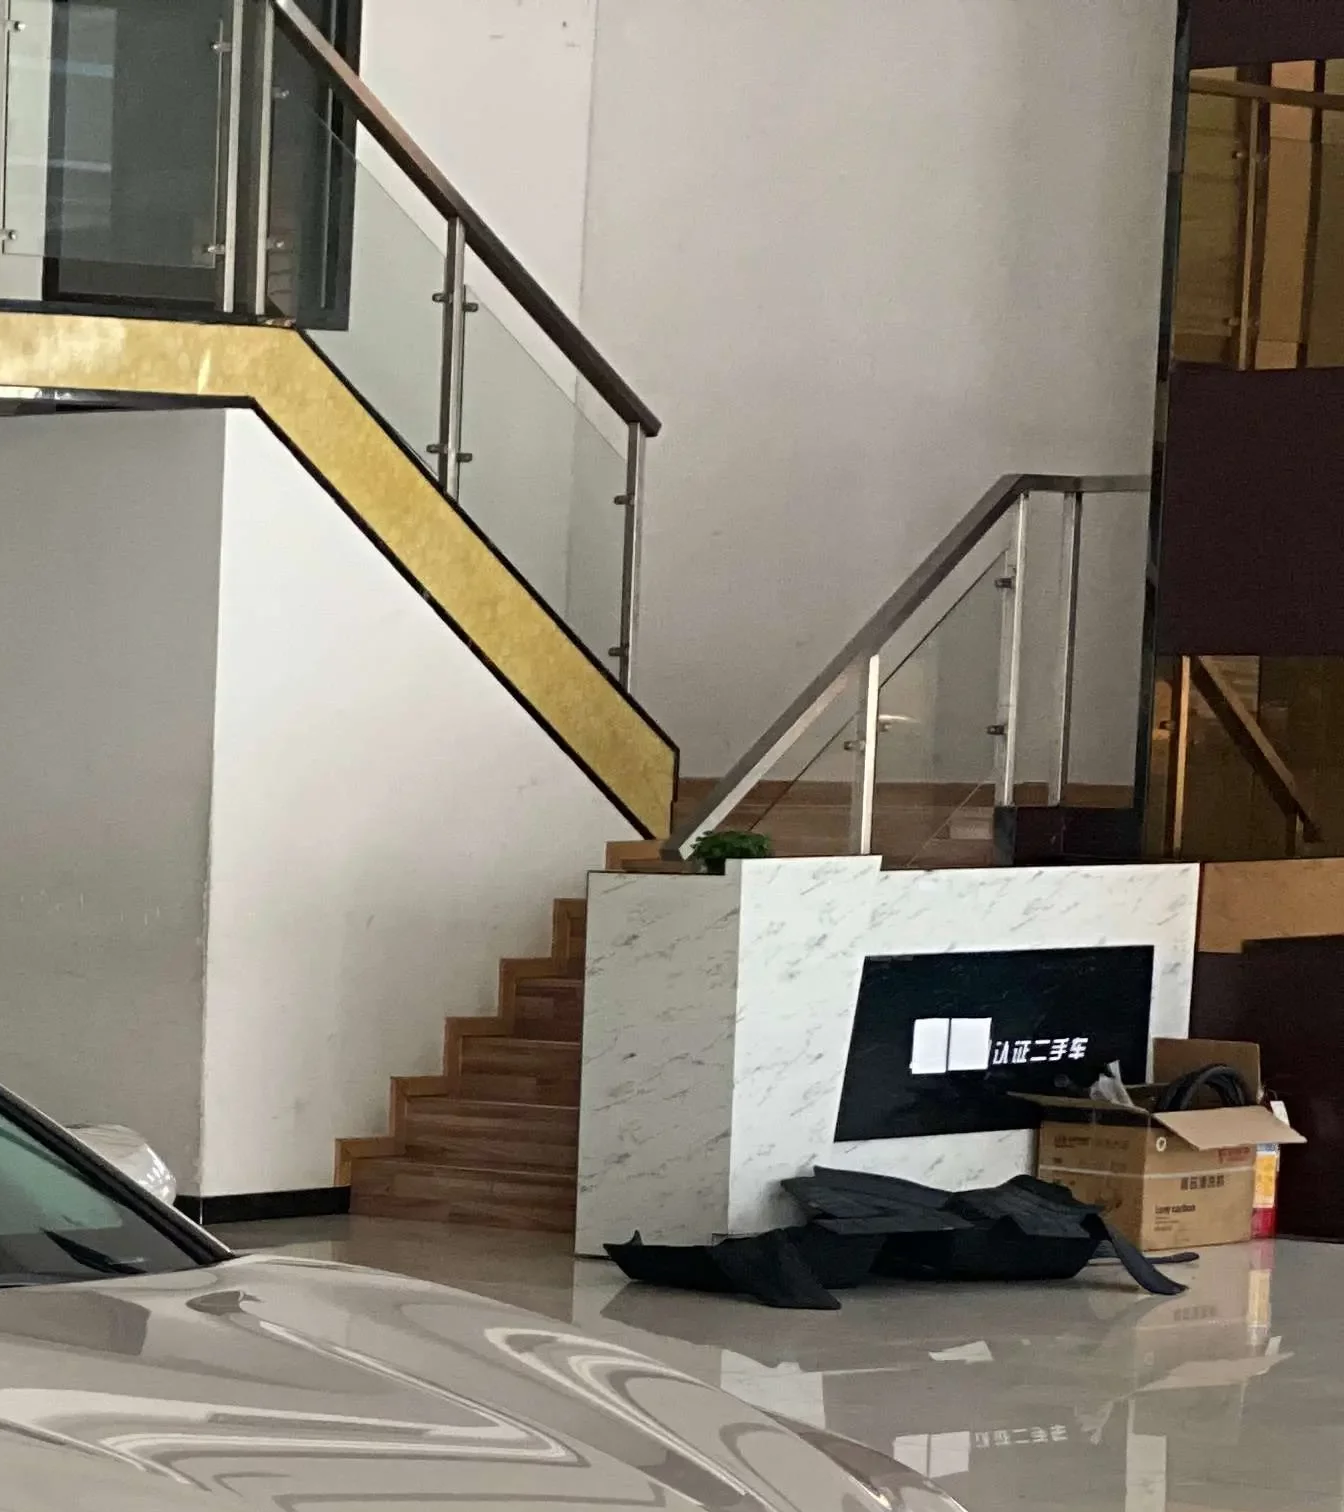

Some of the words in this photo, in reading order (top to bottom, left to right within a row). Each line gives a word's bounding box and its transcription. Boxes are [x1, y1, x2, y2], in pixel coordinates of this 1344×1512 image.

[992, 1037, 1089, 1065] 认证二手车
